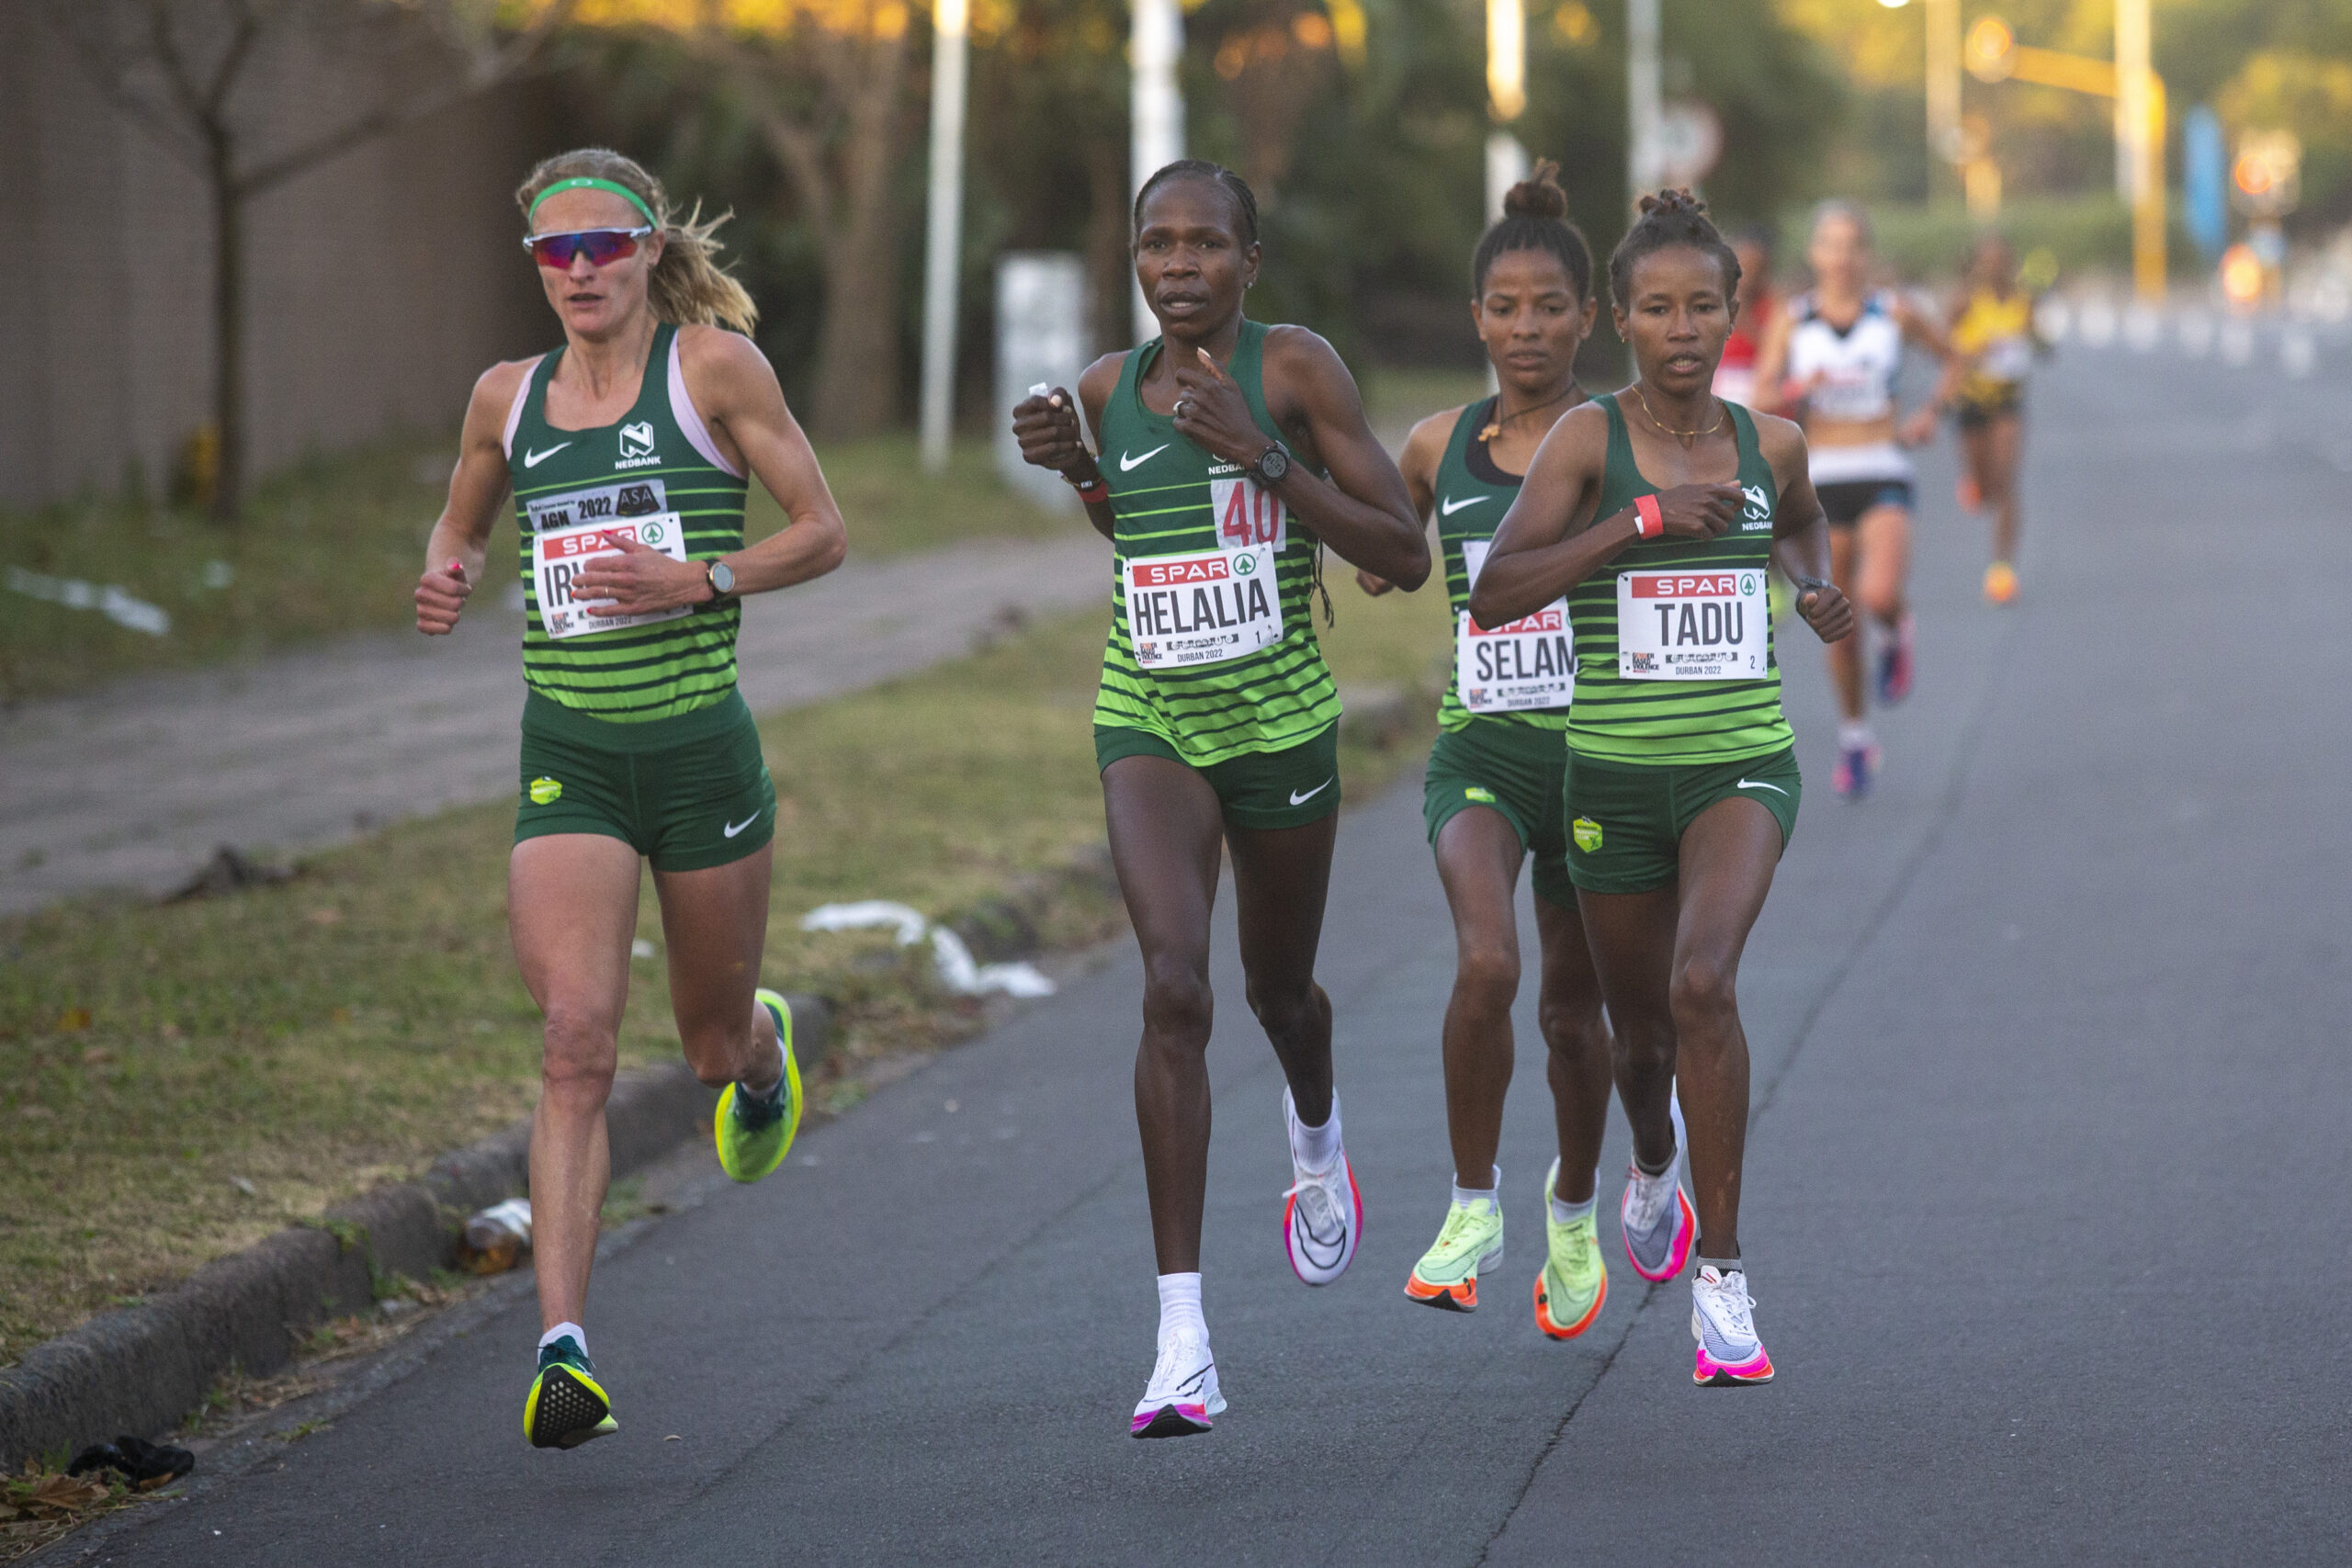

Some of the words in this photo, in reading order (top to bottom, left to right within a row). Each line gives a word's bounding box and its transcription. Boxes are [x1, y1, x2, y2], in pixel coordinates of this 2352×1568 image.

[615, 457, 662, 469] NEDBANK
[1208, 462, 1245, 475] NEDBA
[620, 489, 653, 506] ASA
[578, 497, 612, 519] 2022
[1223, 481, 1279, 546] 40
[1742, 521, 1773, 531] NEDBAN
[1150, 560, 1227, 583] SPAR
[1657, 578, 1736, 595] SPAR
[1133, 578, 1271, 637] HELALIA
[1655, 602, 1744, 647] TADU
[1255, 630, 1261, 645] 1
[1177, 650, 1204, 662] DURBAN
[1205, 649, 1223, 660] 2022
[1749, 655, 1756, 670] 2
[1675, 666, 1702, 676] DURBAN
[1704, 665, 1722, 675] 2022
